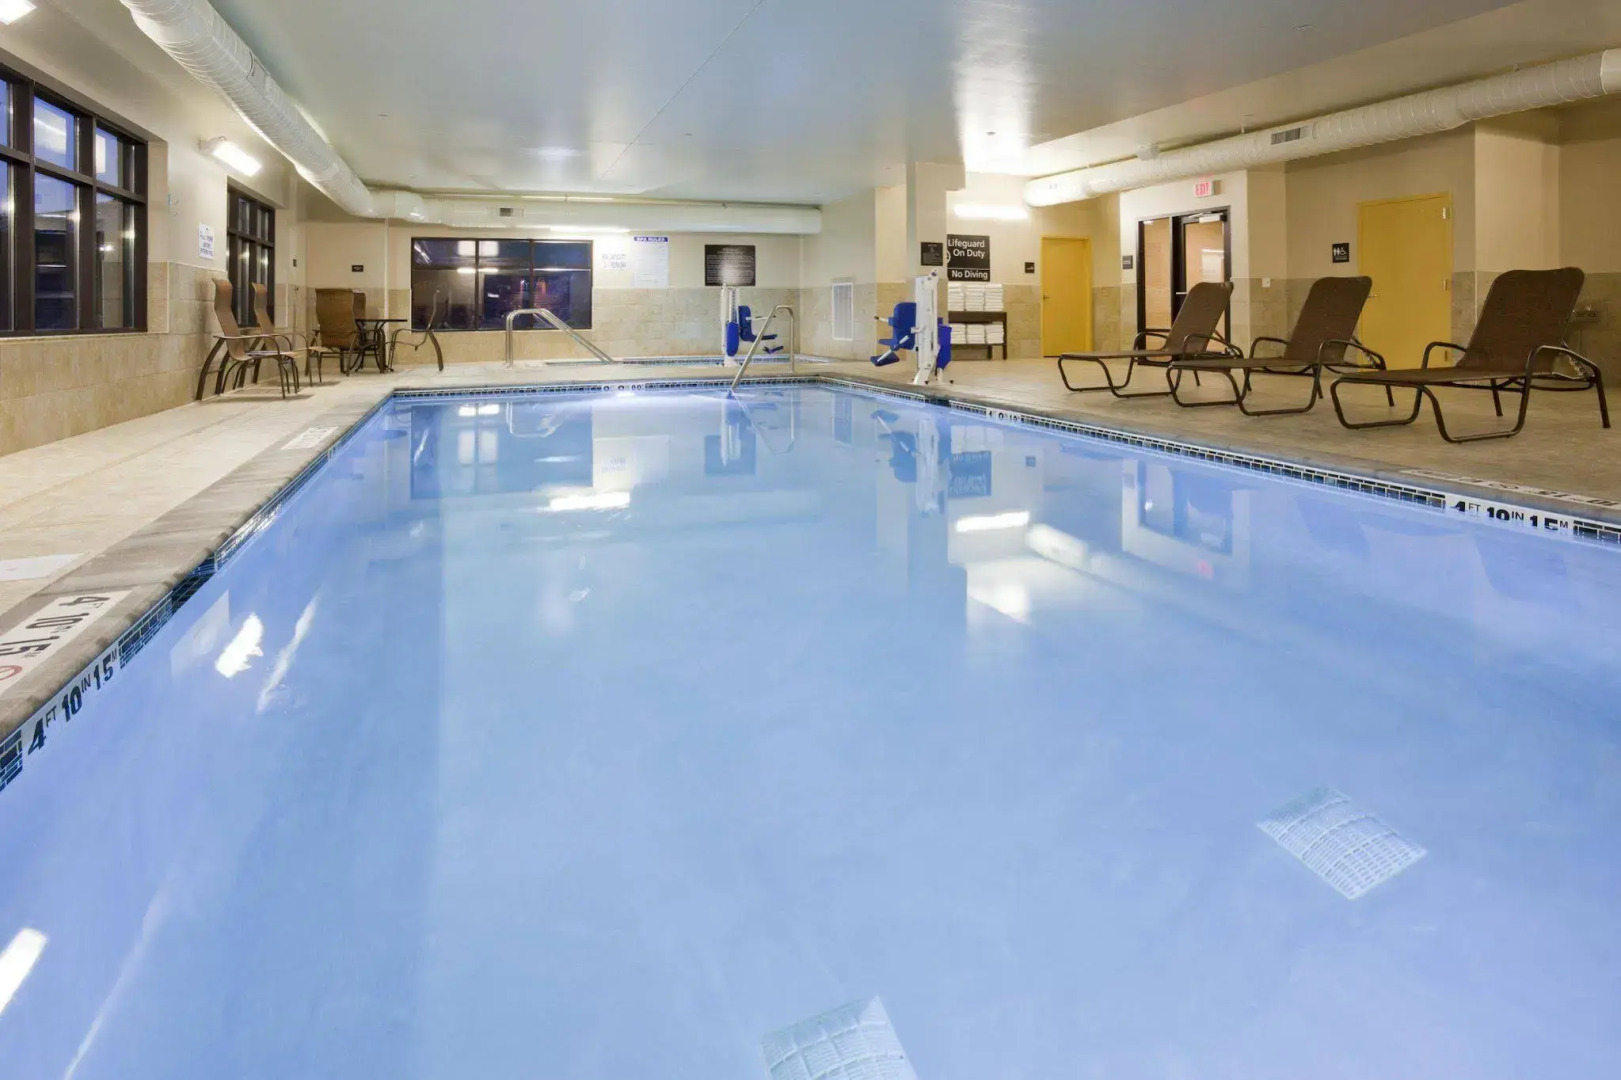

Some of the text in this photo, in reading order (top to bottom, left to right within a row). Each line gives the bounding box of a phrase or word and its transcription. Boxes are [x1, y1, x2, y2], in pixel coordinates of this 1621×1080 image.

[1195, 182, 1210, 196] EXIT
[947, 239, 985, 249] Lifeguard
[966, 249, 985, 259] Duty
[951, 270, 987, 280] No Diving
